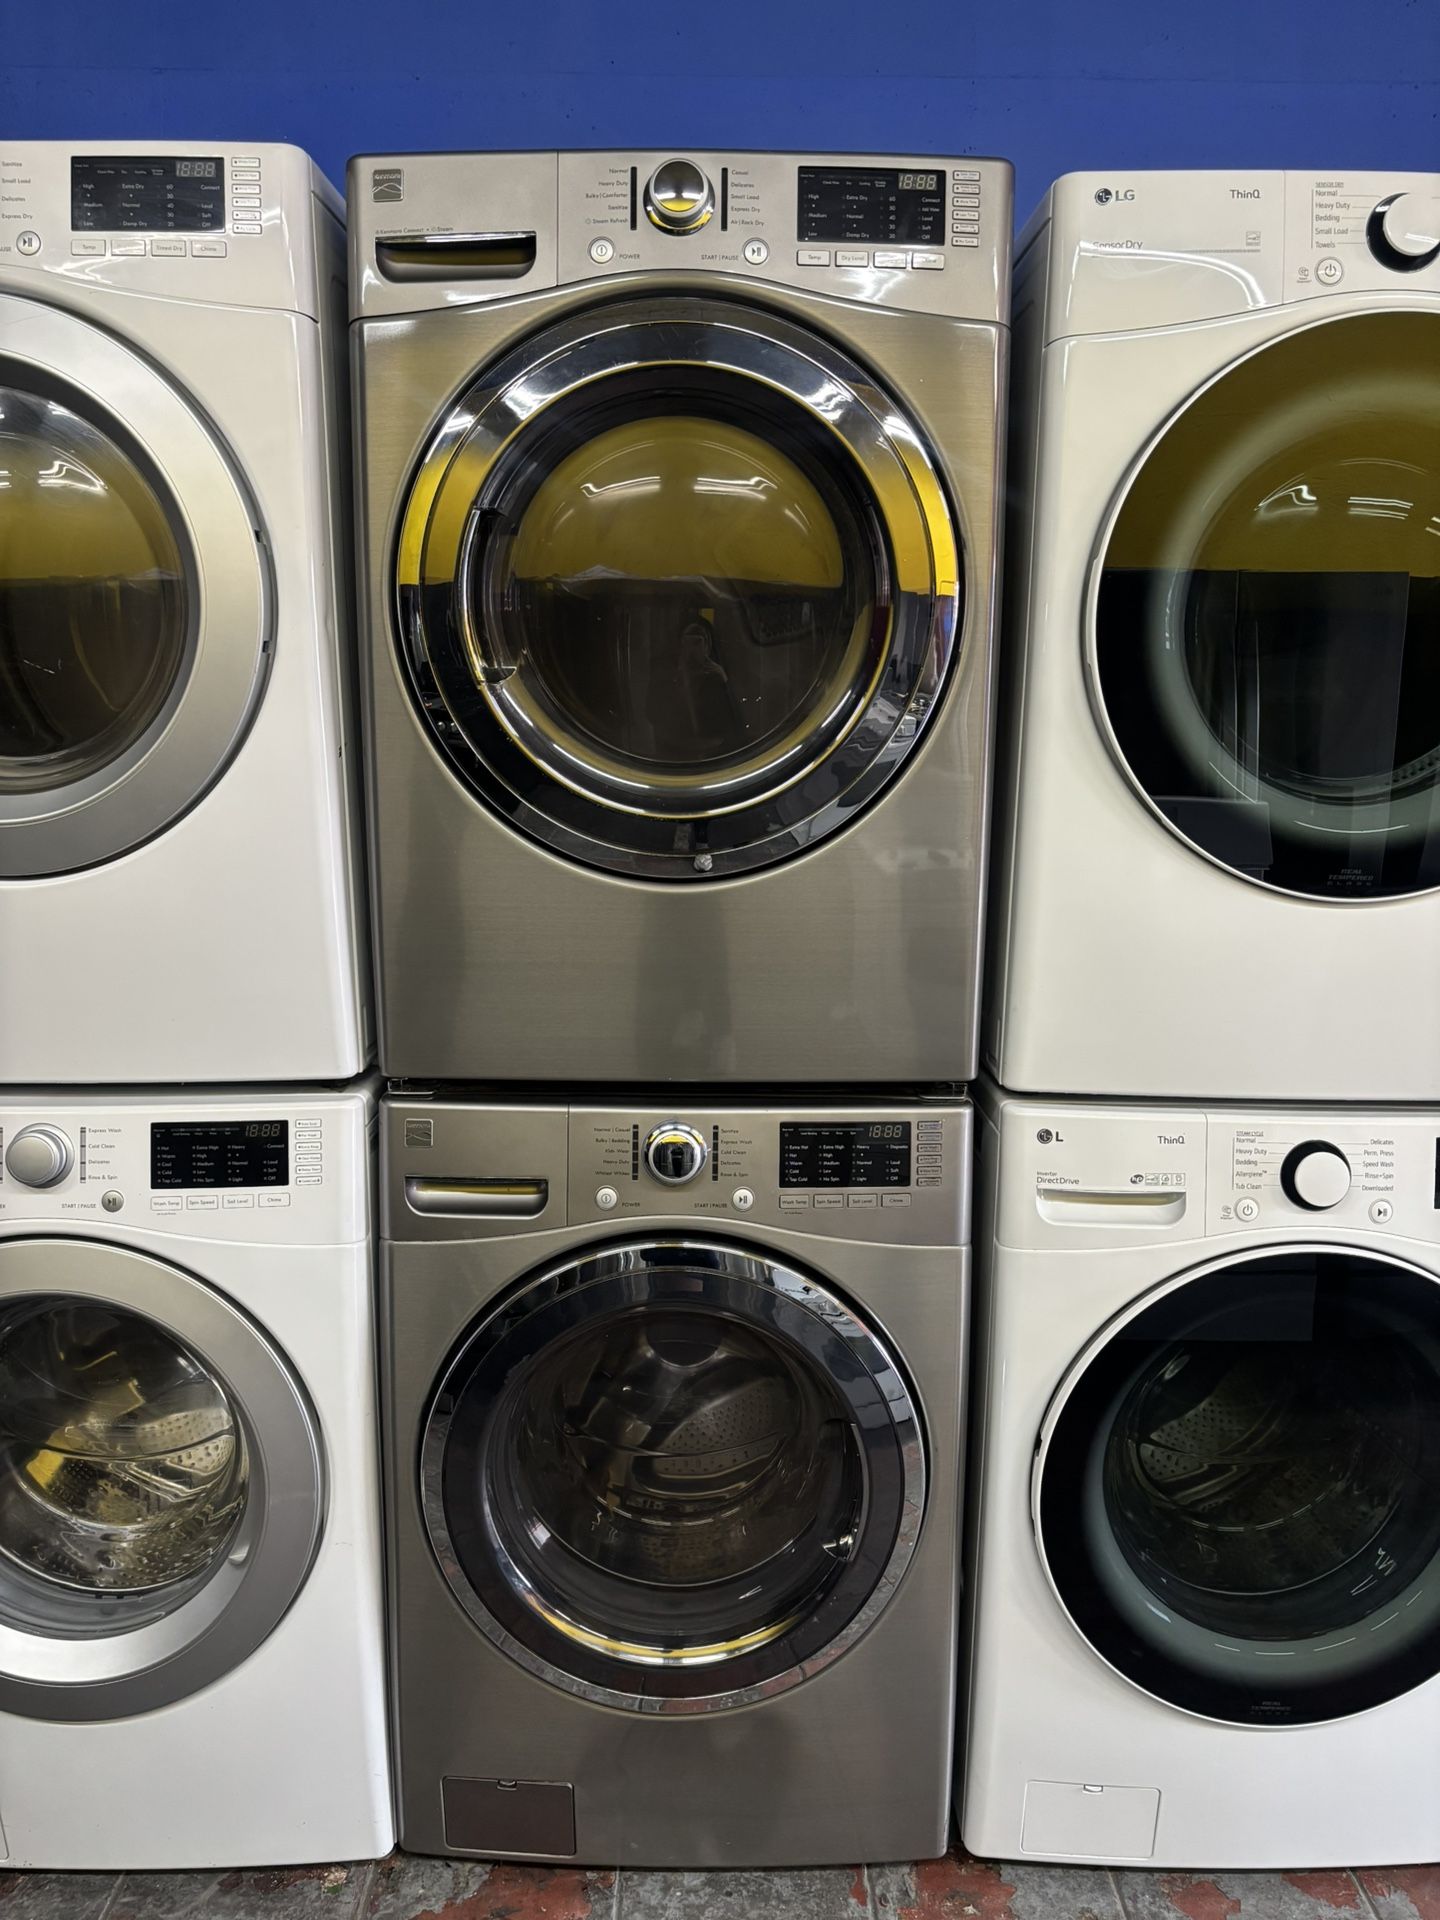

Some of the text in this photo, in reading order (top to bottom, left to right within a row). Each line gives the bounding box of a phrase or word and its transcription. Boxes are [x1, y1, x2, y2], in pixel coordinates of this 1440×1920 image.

[1115, 189, 1135, 202] LG
[1229, 189, 1262, 199] ThinQ
[1335, 202, 1350, 210] Duty
[23, 213, 33, 221] Dry
[1315, 215, 1340, 223] Bedding
[1315, 227, 1348, 235] Small Load
[1315, 240, 1336, 248] Towels
[1157, 1135, 1185, 1145] ThinQ
[1253, 1148, 1267, 1156] Duty
[1362, 1160, 1379, 1168] Speed
